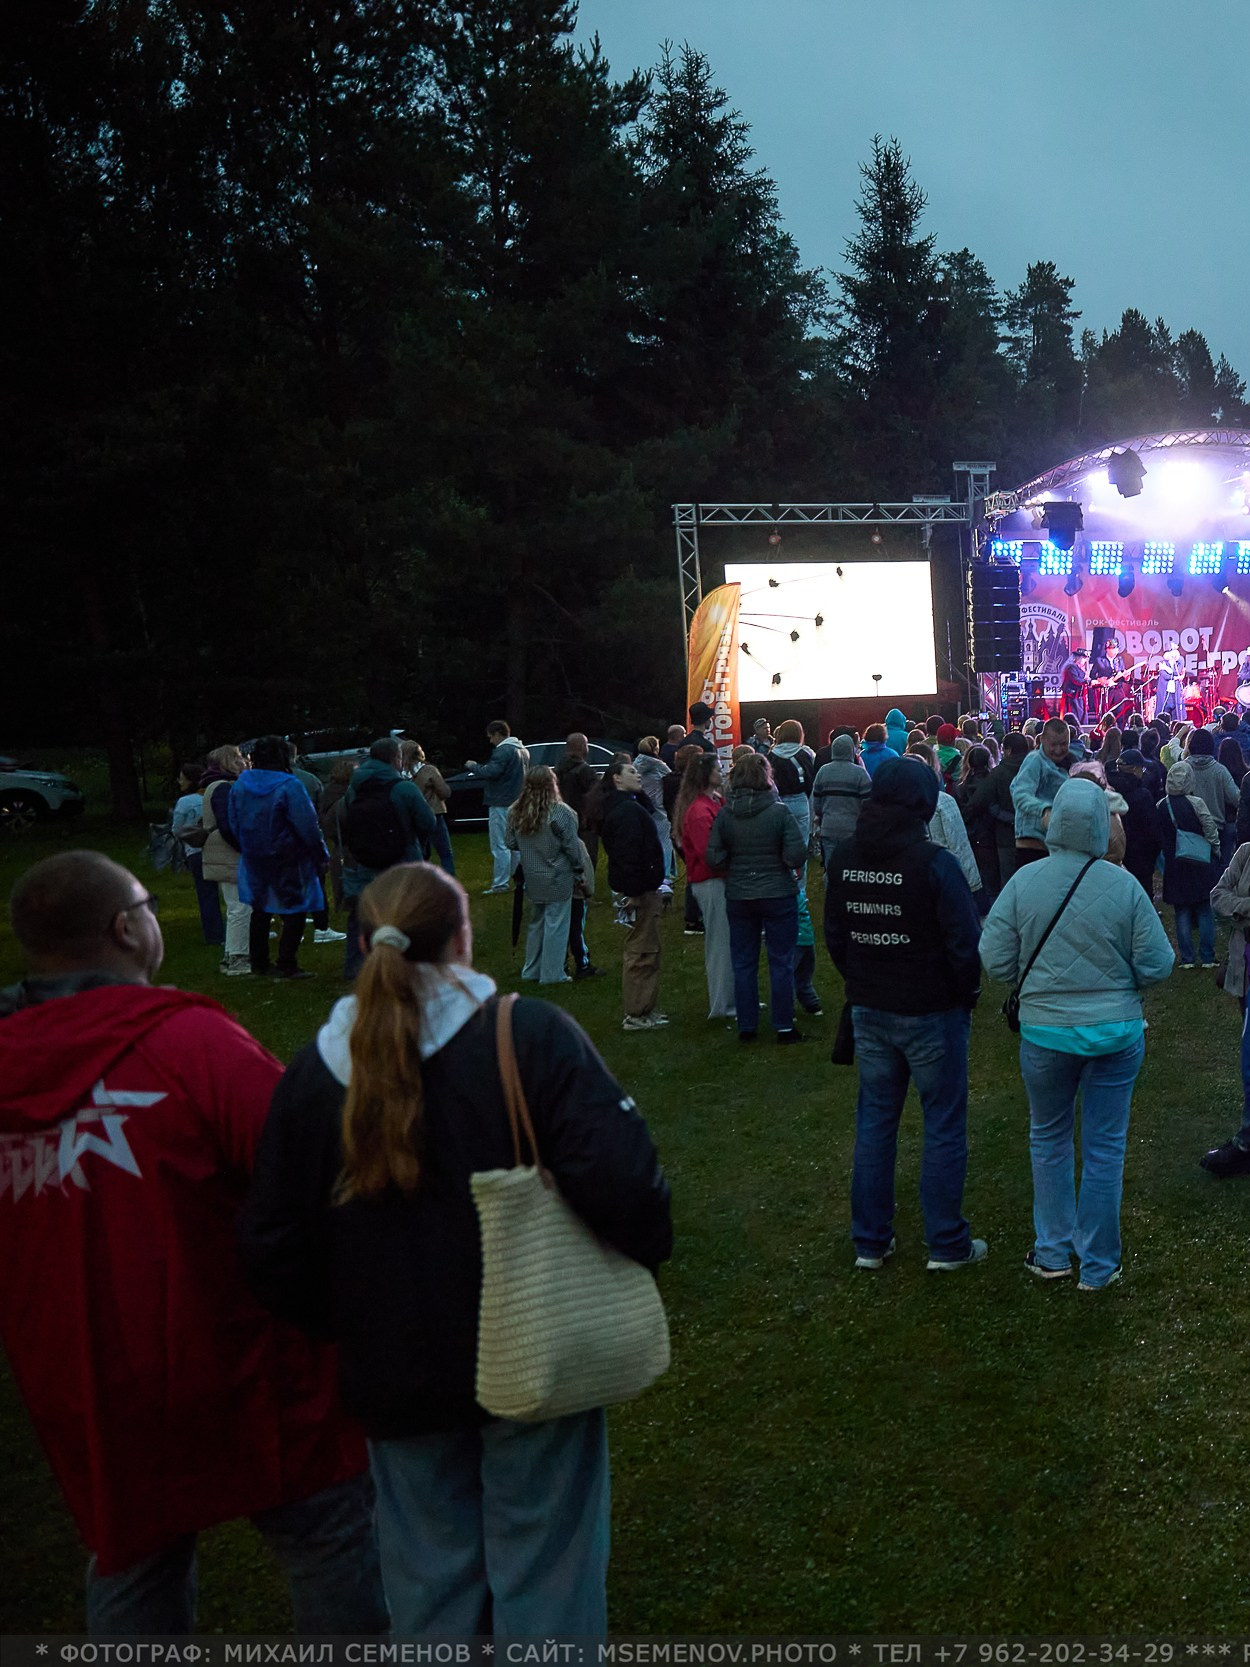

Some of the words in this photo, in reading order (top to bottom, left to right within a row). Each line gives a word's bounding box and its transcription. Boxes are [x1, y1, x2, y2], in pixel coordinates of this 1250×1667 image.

[1085, 618, 1160, 628] рок-фестиваль
[714, 622, 734, 741] ГОРЕ-ГРЯЗЬ
[842, 869, 903, 885] PERISOSG
